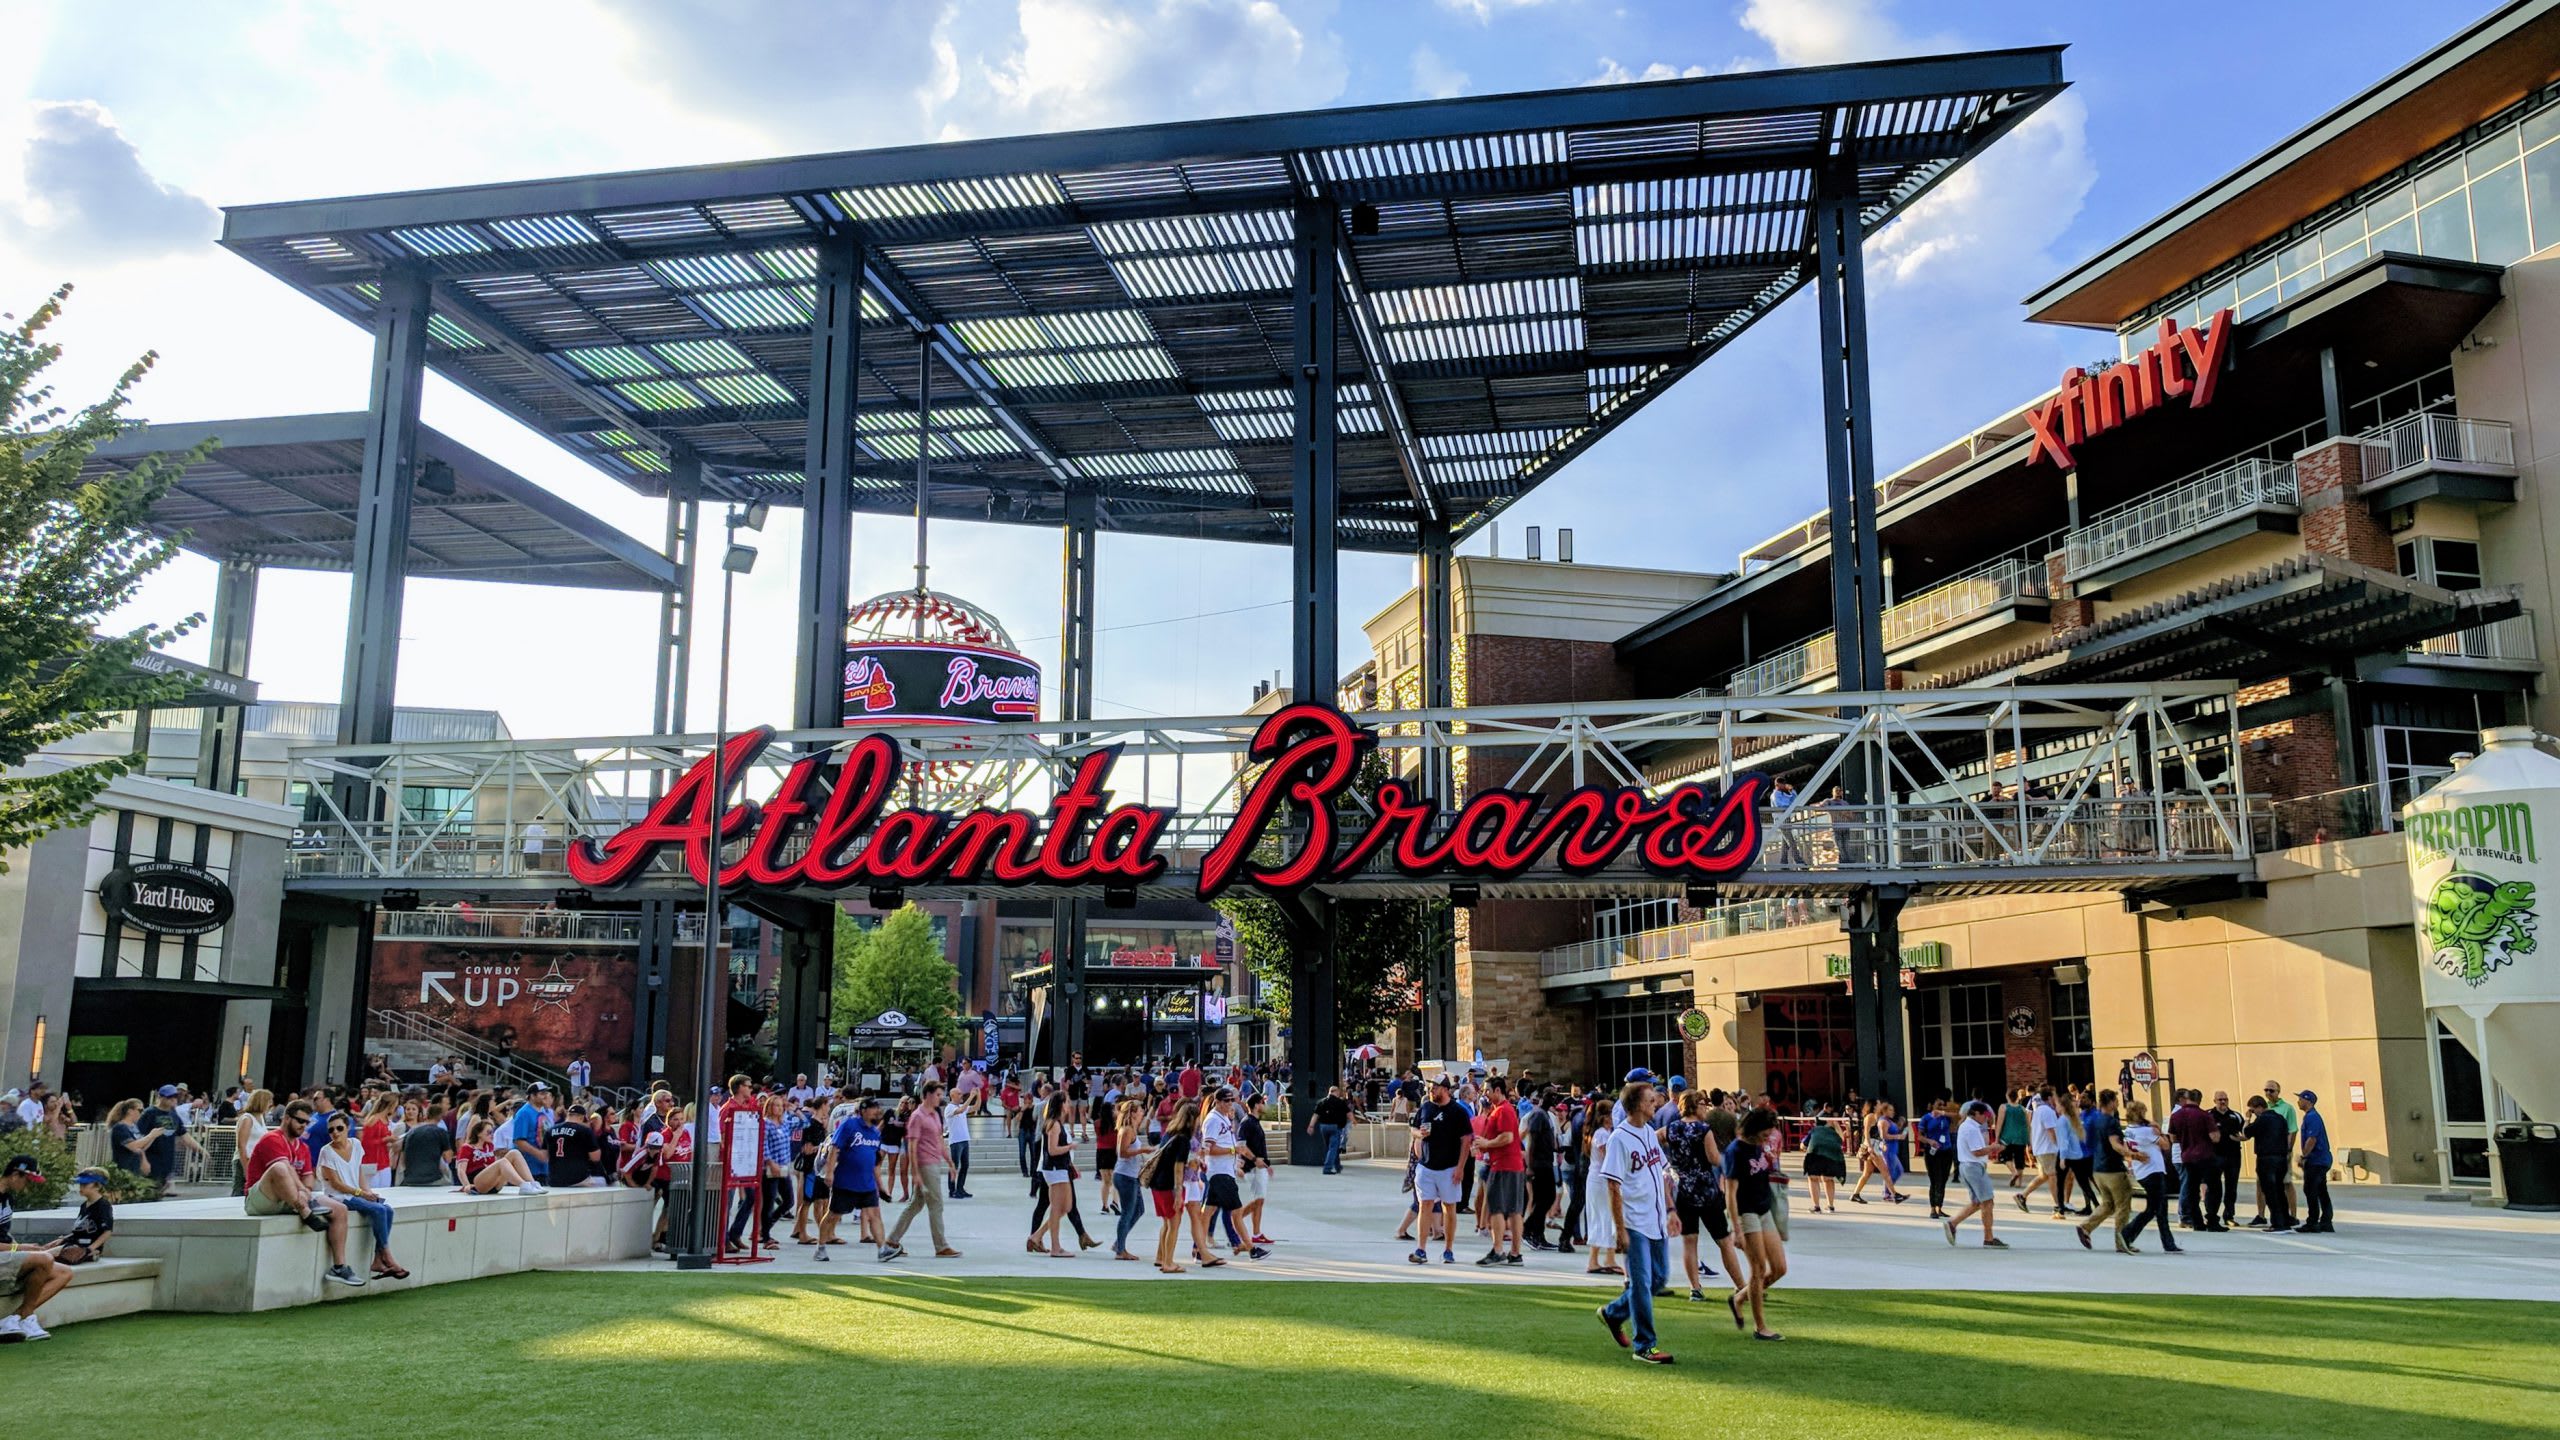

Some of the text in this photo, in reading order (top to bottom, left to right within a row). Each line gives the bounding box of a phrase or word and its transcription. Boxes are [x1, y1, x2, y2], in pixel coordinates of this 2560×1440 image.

[2023, 308, 2234, 470] xfinity
[213, 679, 238, 695] BAR
[567, 702, 1766, 900] Atlanta Braves
[2404, 802, 2538, 864] TERRAPIN
[2459, 848, 2474, 857] ATL
[2477, 849, 2523, 864] BREWLAB
[132, 882, 215, 914] Yard House
[465, 965, 521, 975] COWBOY
[464, 977, 520, 1008] UP
[531, 983, 575, 993] PBR
[551, 1127, 577, 1138] ALBIES
[556, 1137, 565, 1157] 1
